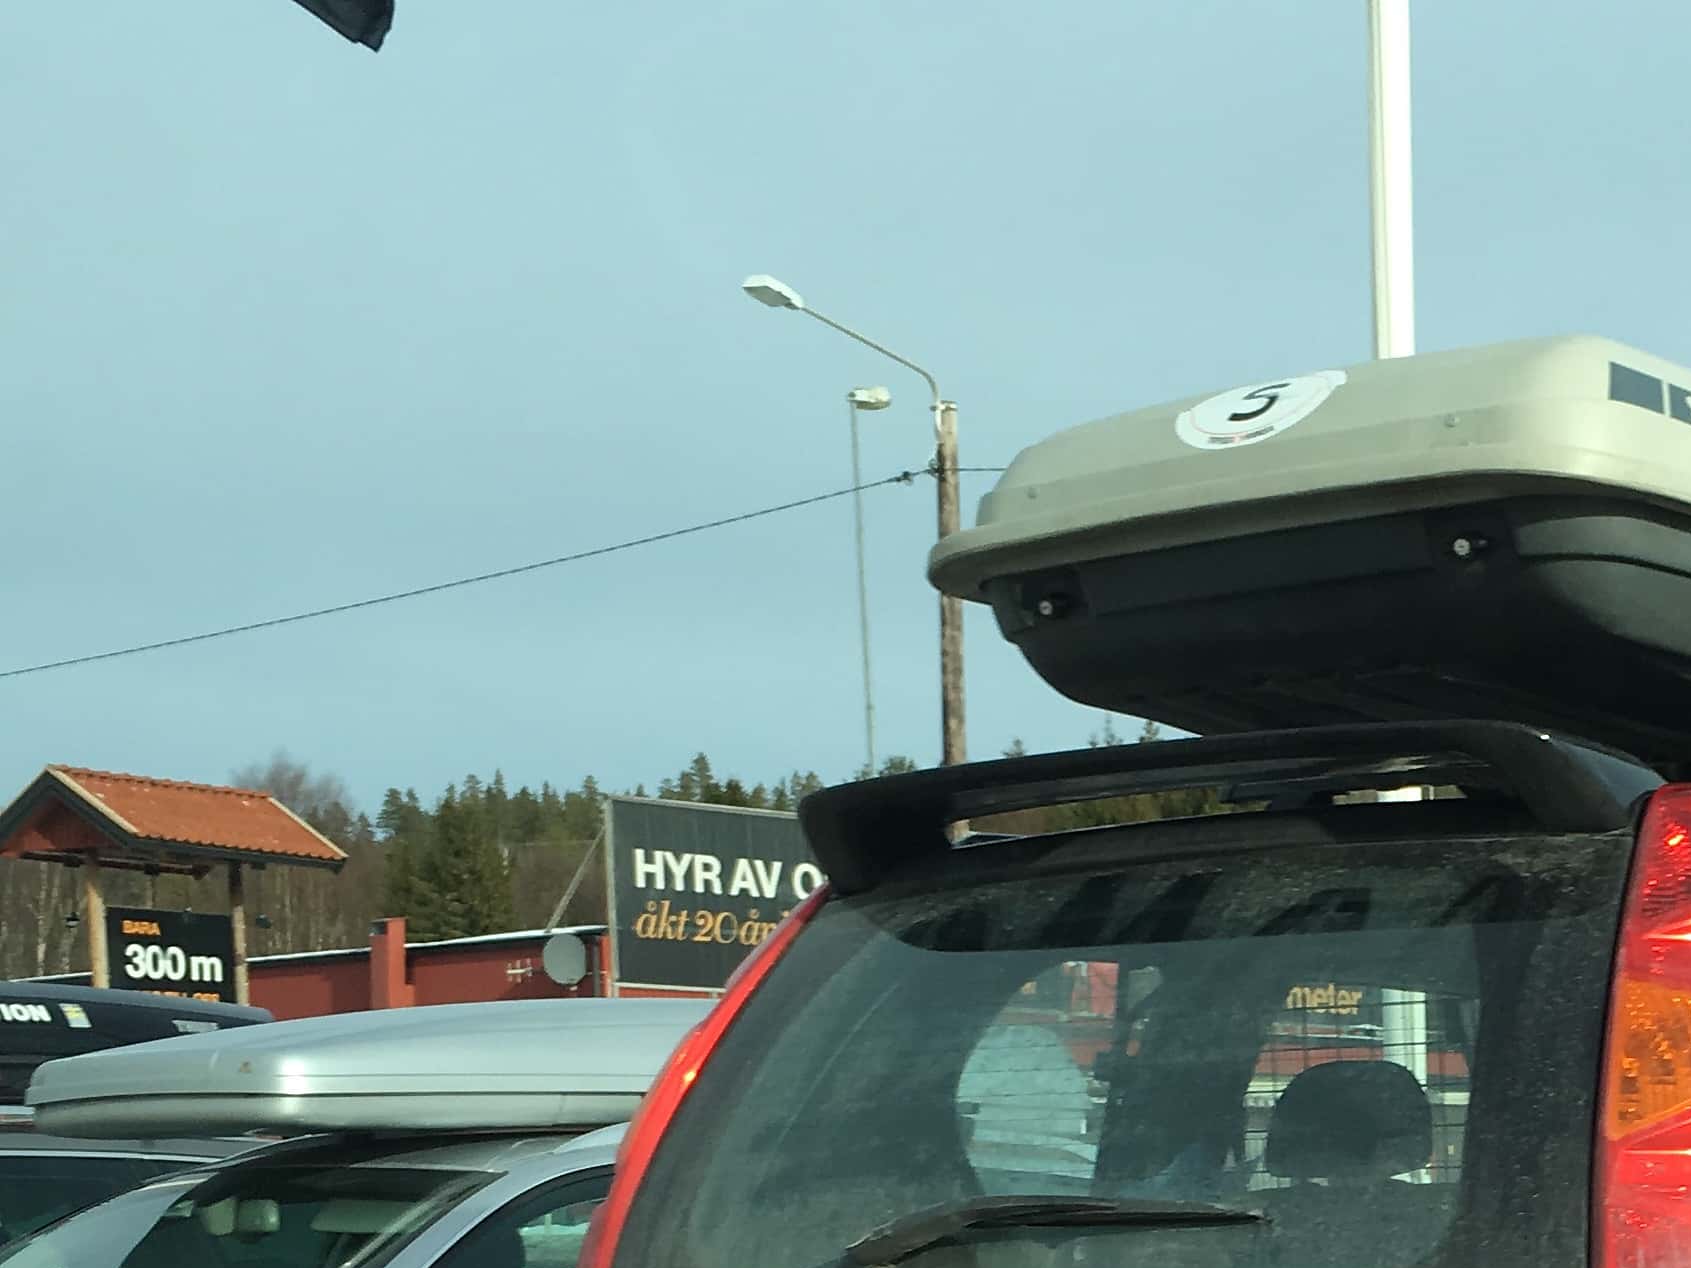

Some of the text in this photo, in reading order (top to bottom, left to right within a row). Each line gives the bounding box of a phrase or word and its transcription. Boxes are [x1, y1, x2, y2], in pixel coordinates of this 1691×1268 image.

[1227, 383, 1291, 421] 5
[633, 848, 829, 900] HYR AV O
[632, 900, 690, 941] åkt
[692, 909, 738, 944] 20
[125, 943, 223, 982] 300 m
[1286, 982, 1362, 1016] meter
